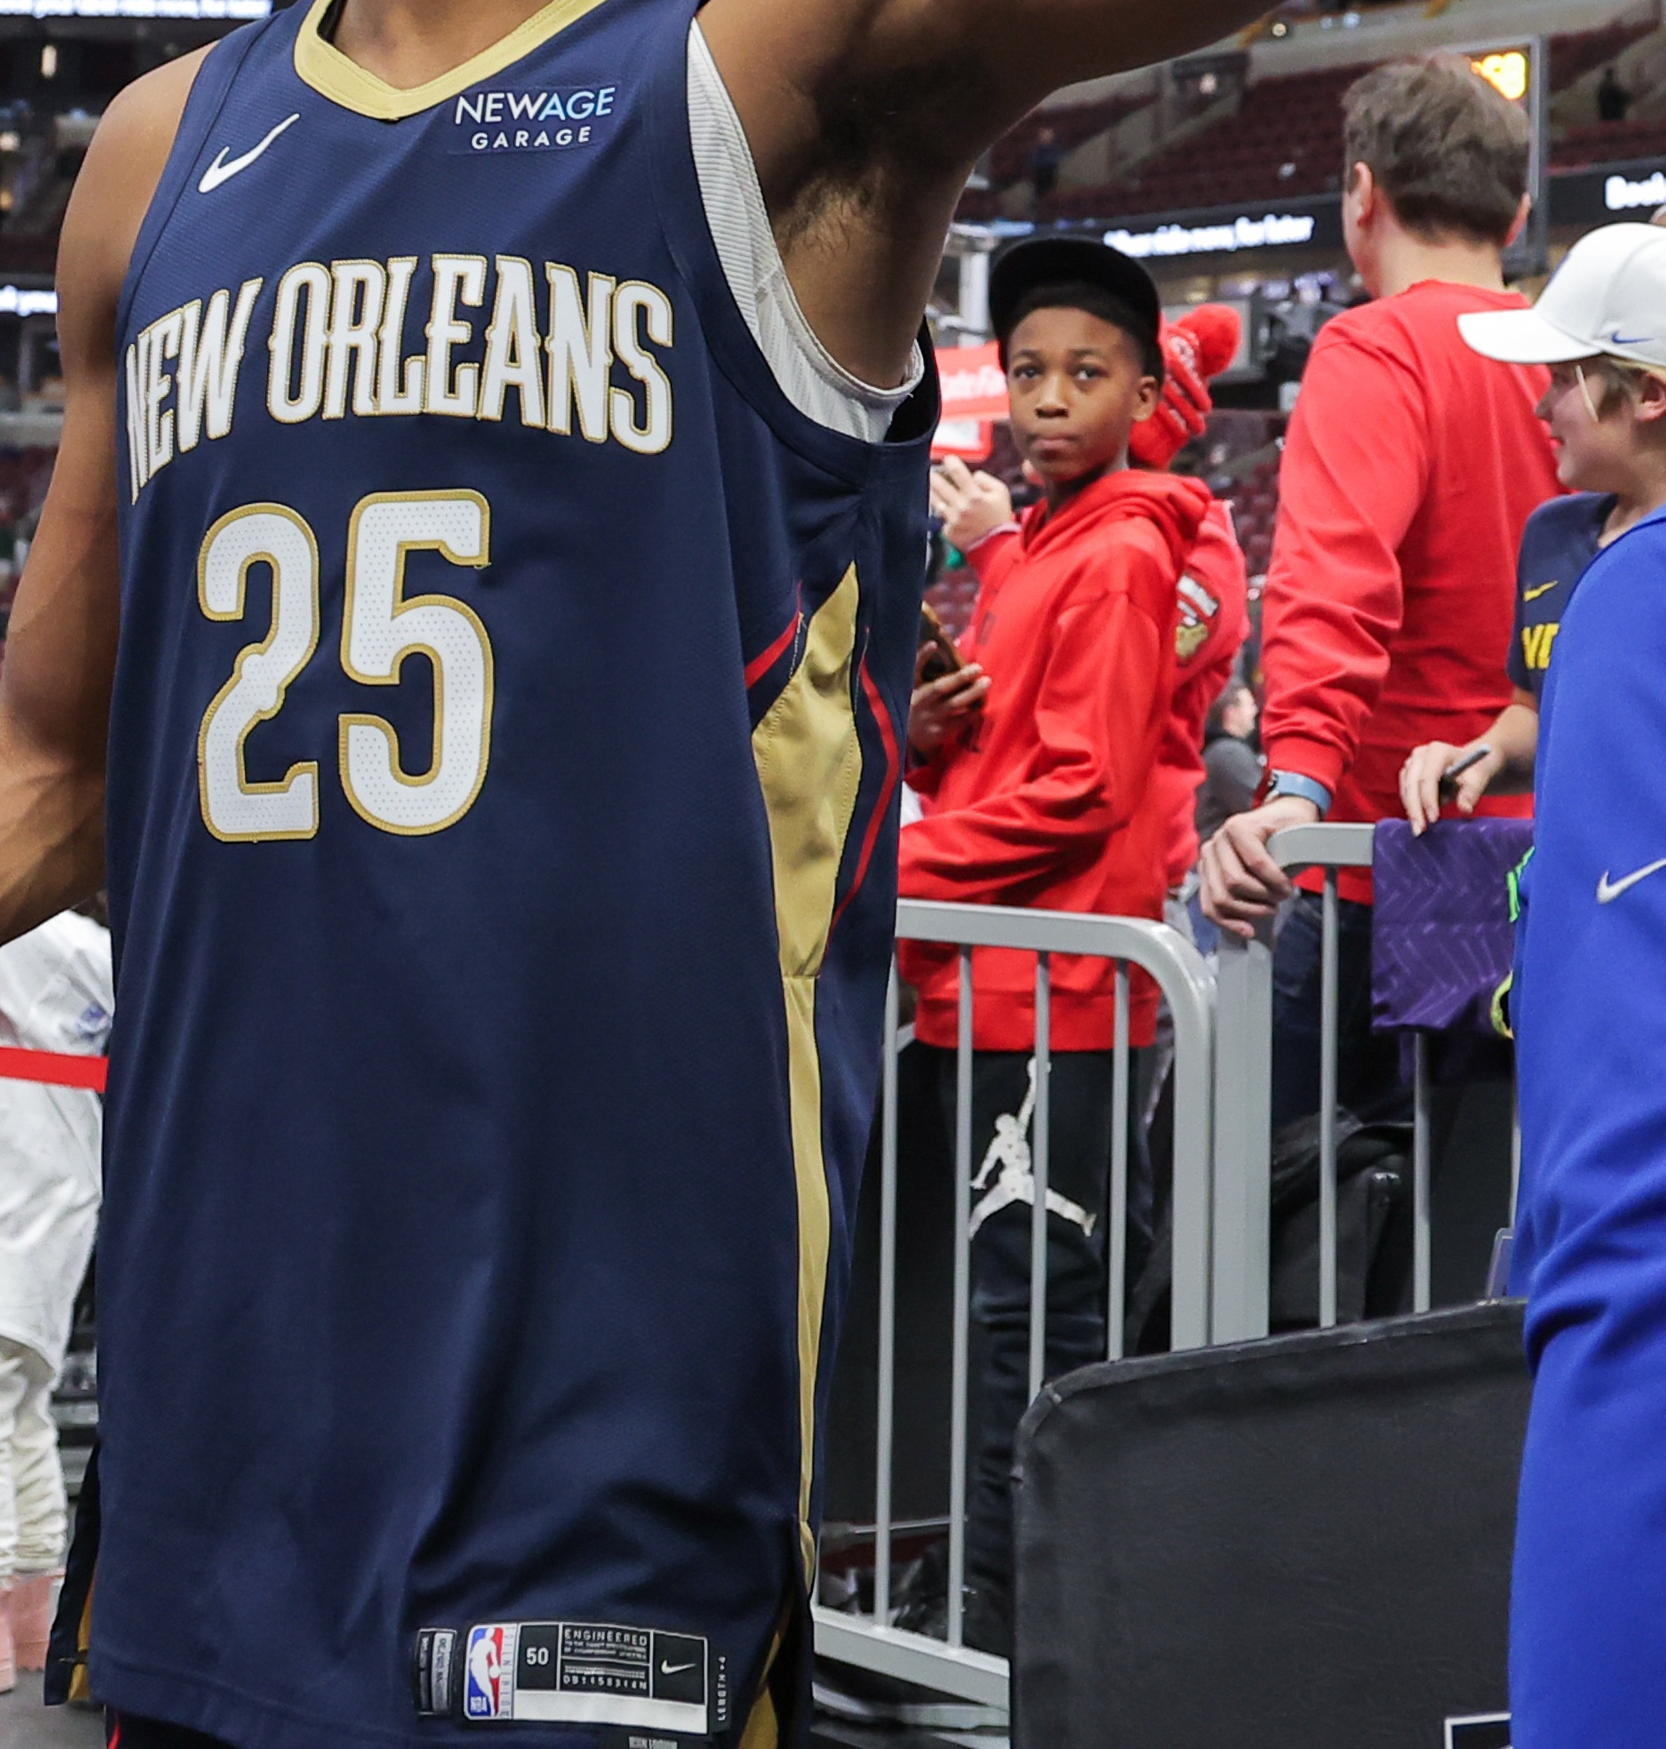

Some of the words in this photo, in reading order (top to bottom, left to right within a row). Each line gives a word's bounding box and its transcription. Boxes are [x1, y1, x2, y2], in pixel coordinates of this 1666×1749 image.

[455, 86, 617, 127] NEWAGE
[471, 125, 592, 151] GARAGE
[1263, 215, 1313, 243] later
[125, 276, 264, 507] NEW
[266, 252, 676, 456] ORLEANS
[196, 487, 494, 844] 25
[564, 1628, 648, 1647] ENGINEERED
[526, 1647, 549, 1665] 50
